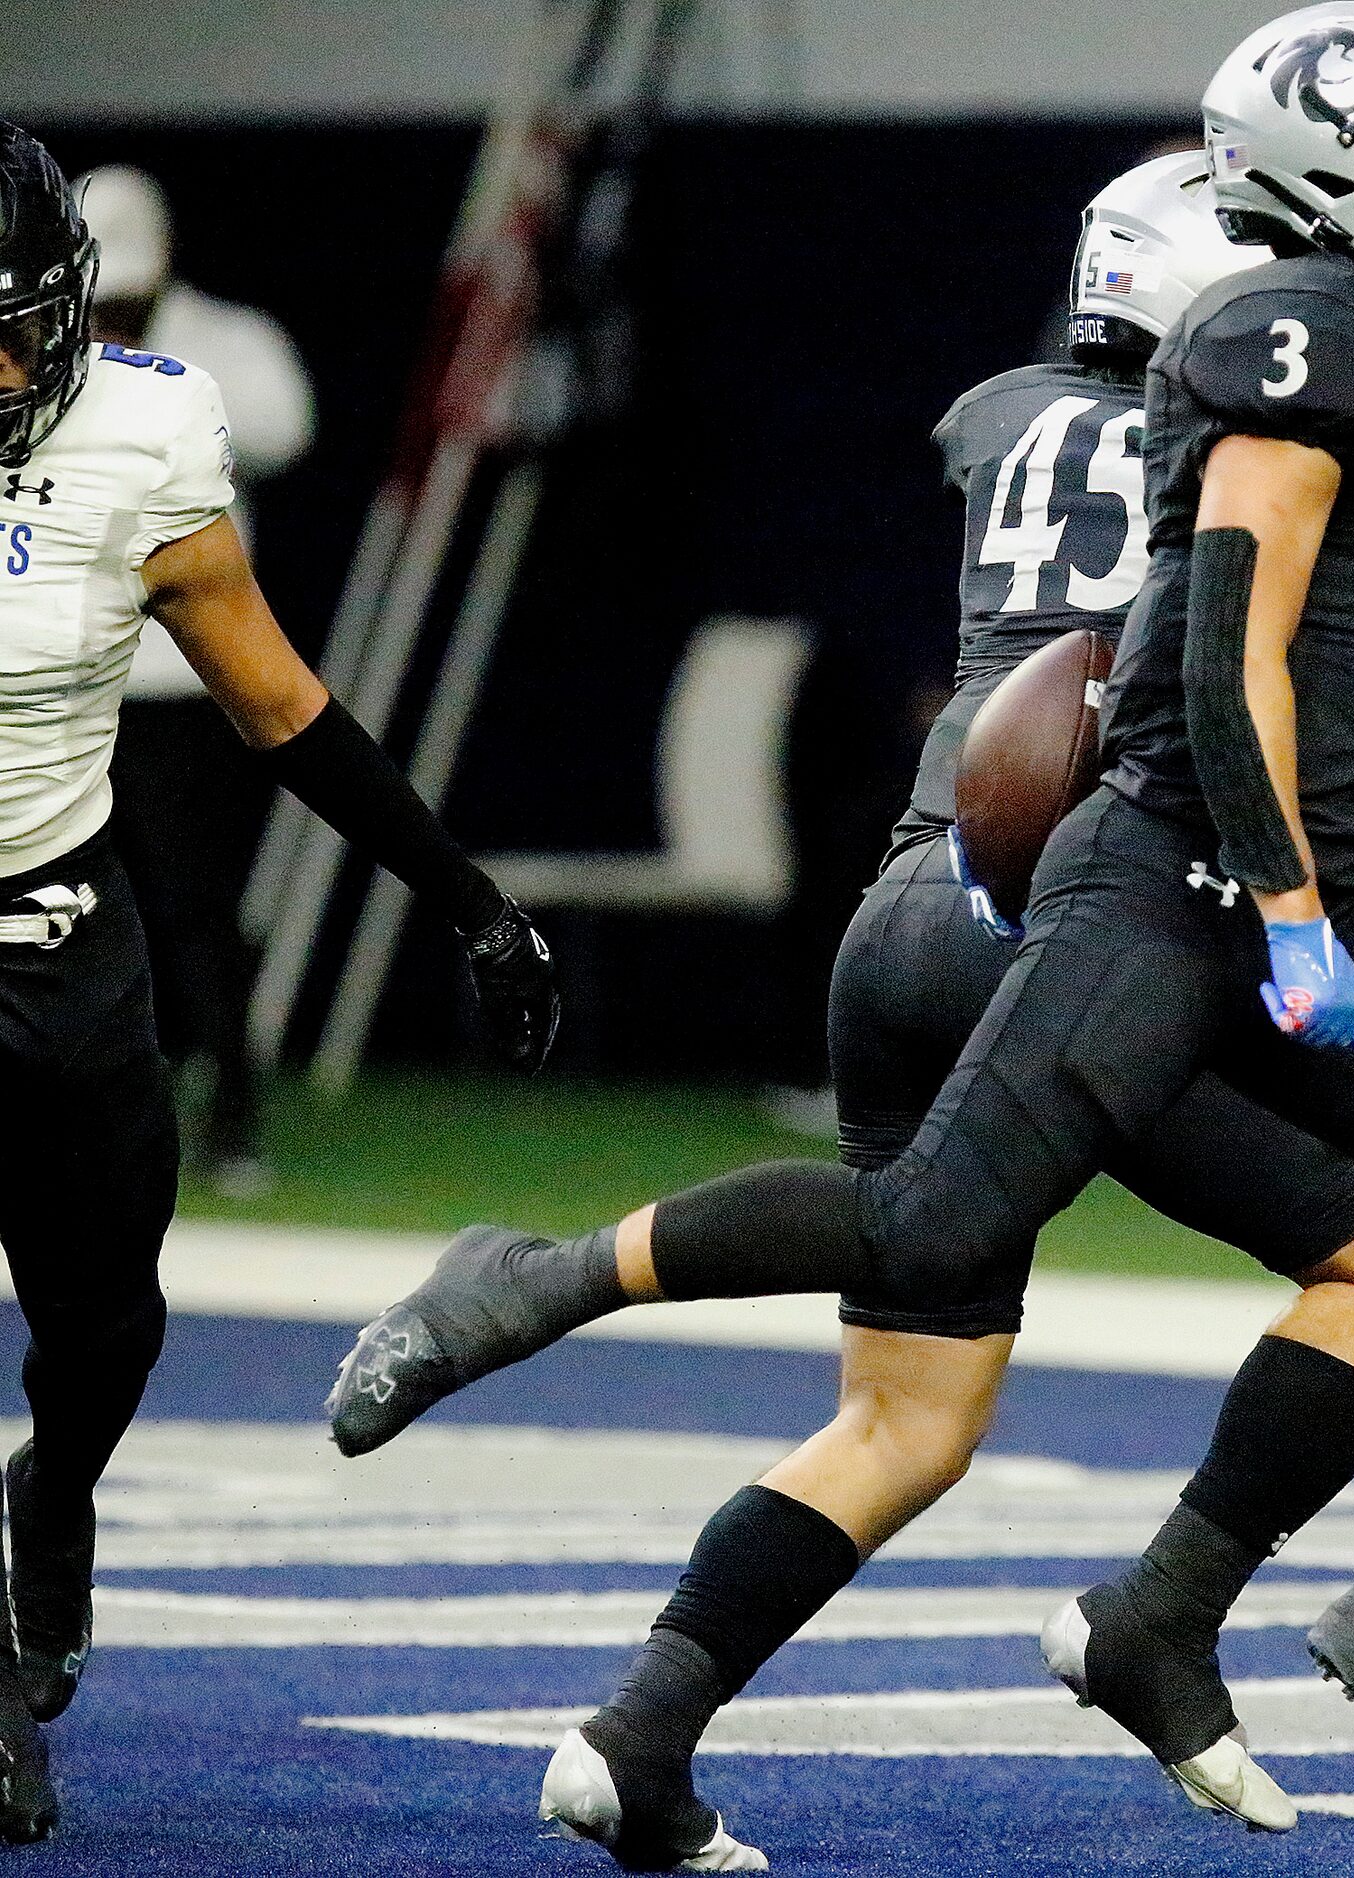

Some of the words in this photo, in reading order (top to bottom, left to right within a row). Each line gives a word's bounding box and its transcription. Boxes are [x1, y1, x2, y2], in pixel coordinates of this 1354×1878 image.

[1068, 319, 1108, 345] HSIDE
[1261, 318, 1310, 398] 3
[978, 395, 1148, 611] 45
